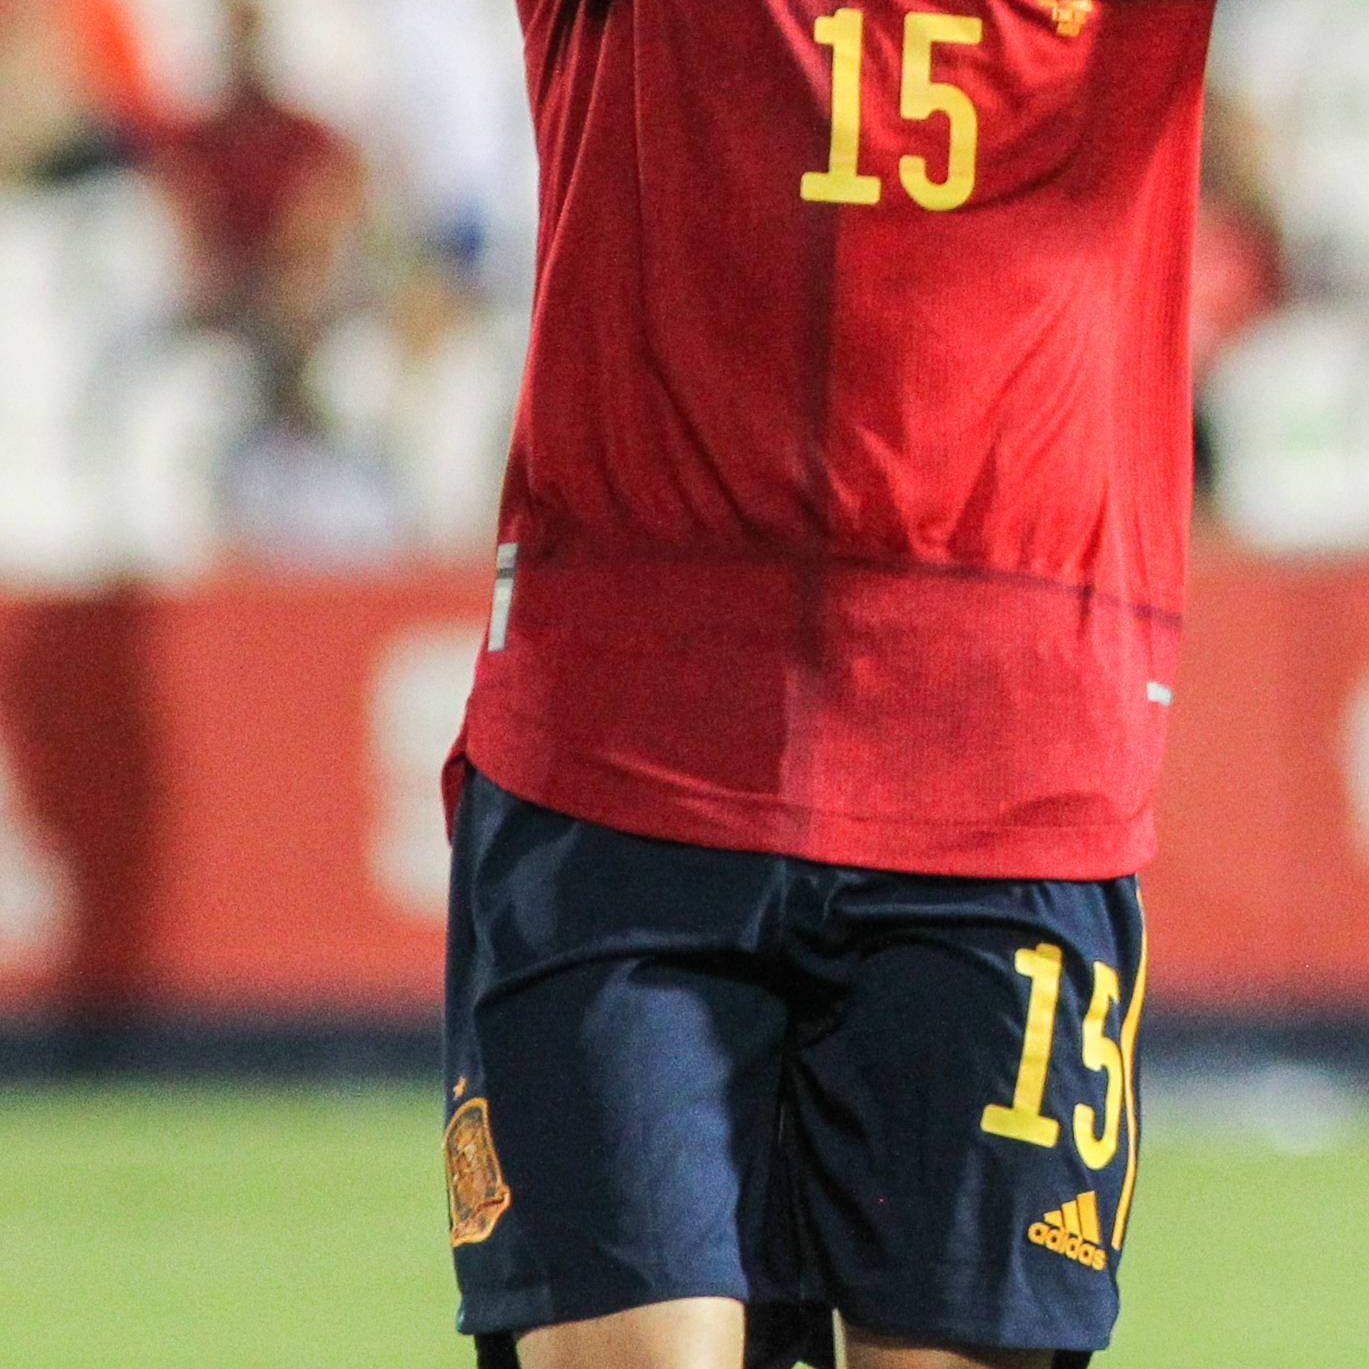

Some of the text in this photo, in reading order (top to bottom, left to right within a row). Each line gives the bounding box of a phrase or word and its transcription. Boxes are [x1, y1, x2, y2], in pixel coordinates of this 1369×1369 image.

[801, 8, 983, 210] 15
[980, 943, 1123, 1170] 15
[1027, 1221, 1107, 1271] adidas
